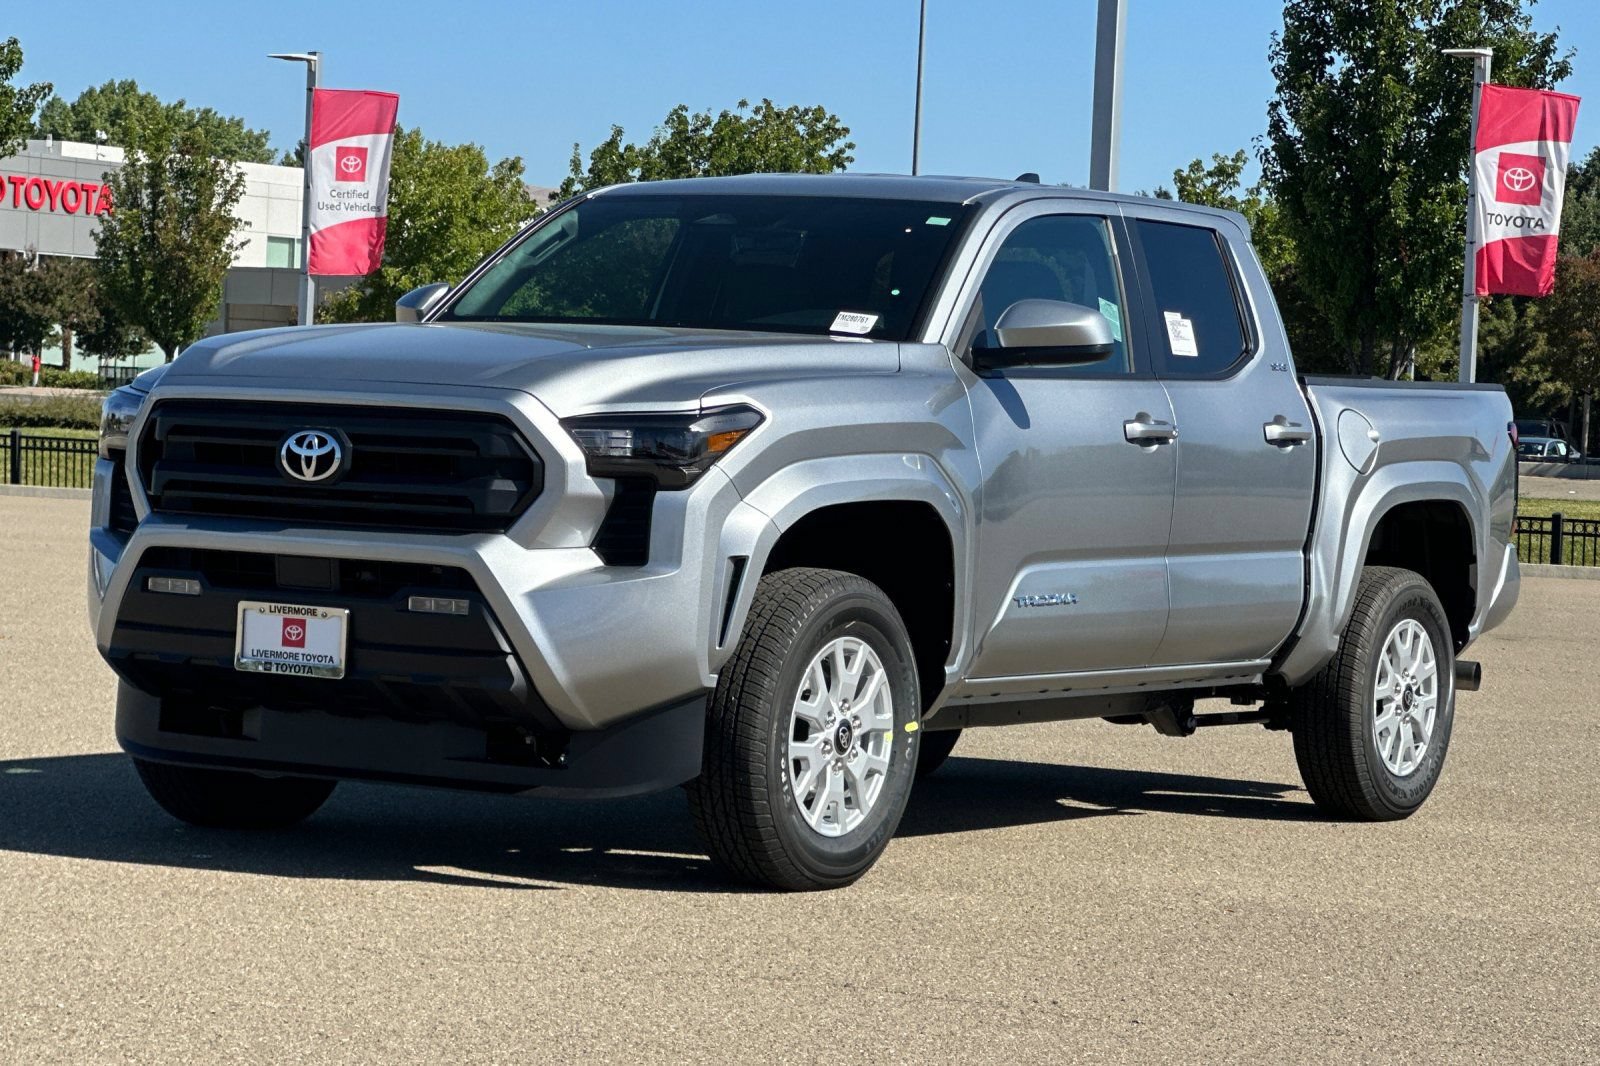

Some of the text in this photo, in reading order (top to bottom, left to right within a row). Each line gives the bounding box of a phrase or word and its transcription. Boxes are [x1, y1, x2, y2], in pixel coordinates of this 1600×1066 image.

[8, 176, 113, 216] TOYOTA
[329, 189, 370, 199] Certified
[317, 202, 382, 212] Used Vehicles
[1487, 213, 1545, 229] TOYOTA
[269, 605, 318, 616] LIVERMORE
[251, 649, 335, 664] LIVERMORE TOYOTA
[274, 663, 314, 675] TOYOTA
